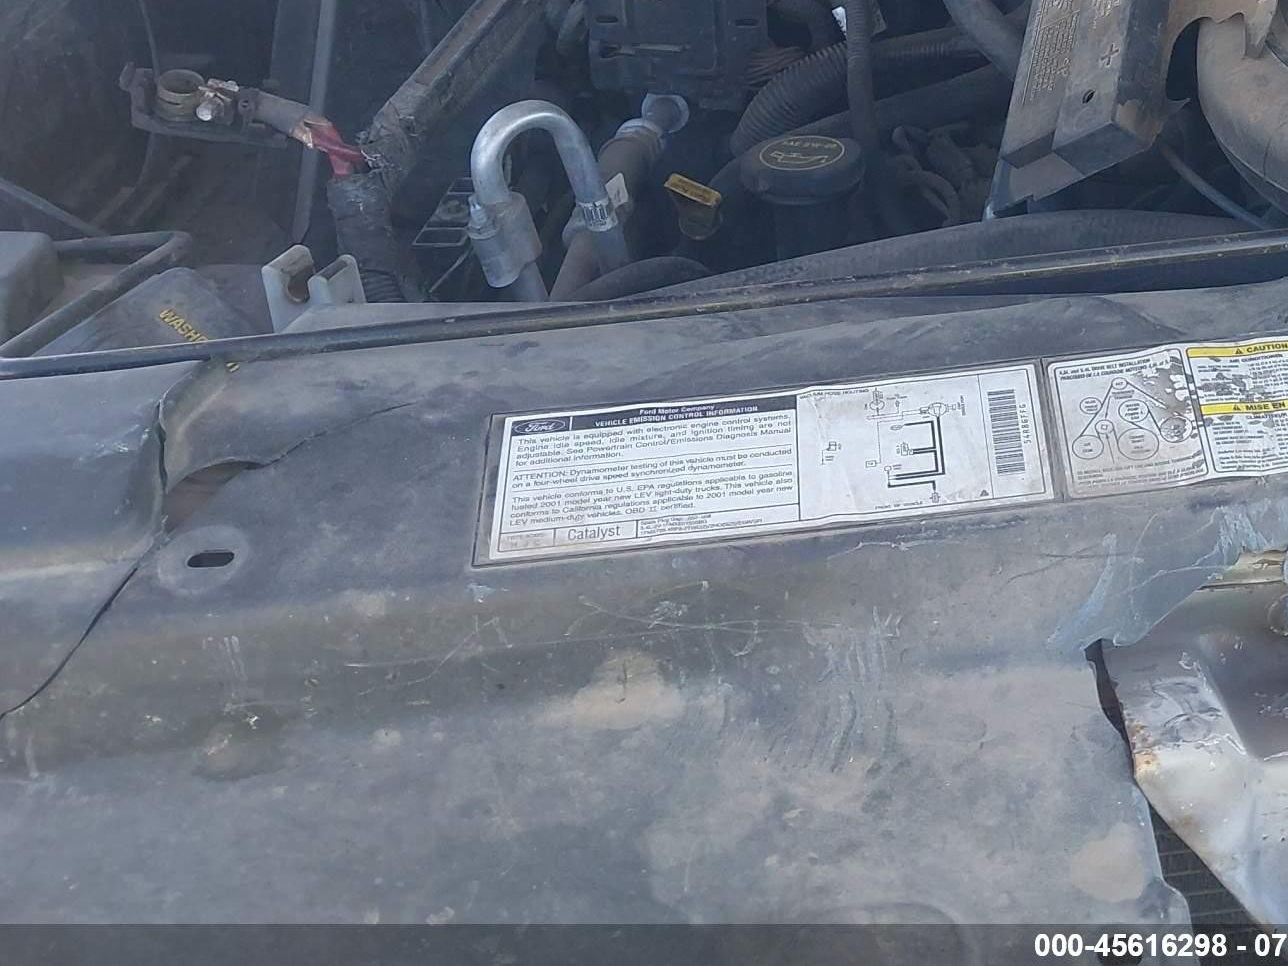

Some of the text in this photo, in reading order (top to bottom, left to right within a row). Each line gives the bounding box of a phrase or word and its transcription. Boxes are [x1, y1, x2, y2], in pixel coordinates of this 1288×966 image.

[1246, 343, 1288, 354] CAUTION
[595, 406, 758, 427] VEHICLE EMISSION CONTROL INFORMATION
[681, 404, 714, 413] Company
[1245, 402, 1268, 411] MISE
[1271, 399, 1286, 409] EN
[517, 444, 549, 454] Engine
[574, 438, 604, 448] speed,
[609, 436, 625, 444] idle
[630, 433, 665, 442] mixture,
[691, 427, 723, 437] ignition
[728, 424, 754, 433] timing
[540, 435, 570, 443] vehicle
[584, 429, 623, 440] equipped
[647, 424, 687, 433] electronic
[691, 421, 718, 430] engine
[722, 418, 750, 426] control
[754, 414, 791, 424] systems,
[587, 443, 633, 453] Powertrain
[636, 435, 713, 448] Control/Emissions
[717, 431, 758, 441] Diagnosis
[760, 427, 791, 436] Manual
[530, 456, 571, 466] additional
[573, 451, 624, 462] information.
[570, 464, 628, 477] Dynamometer
[630, 463, 658, 471] testing
[685, 457, 714, 465] vehicle
[750, 449, 792, 459] conducted
[534, 477, 578, 487] four-wheel
[580, 474, 600, 482] drive
[603, 472, 629, 481] speed
[631, 466, 686, 478] synchronized
[688, 460, 746, 473] dynamometer.
[512, 496, 530, 504] This
[533, 493, 561, 502] vehicle
[564, 489, 603, 499] conforms
[657, 479, 702, 490] regulations
[705, 475, 745, 485] applicable
[759, 470, 792, 480] gasoline
[540, 500, 561, 508] 2001
[565, 497, 590, 506] model
[593, 496, 612, 504] year
[655, 487, 692, 498] light-duty
[695, 485, 722, 493] trucks.
[725, 482, 742, 490] This
[745, 479, 773, 488] vehicle
[510, 508, 549, 519] conforms
[562, 503, 602, 513] California
[604, 499, 649, 511] regulations
[652, 495, 693, 506] applicable
[729, 489, 753, 497] model
[625, 507, 645, 515] OBD
[660, 502, 695, 512] certified.
[567, 524, 621, 543] Catalyst
